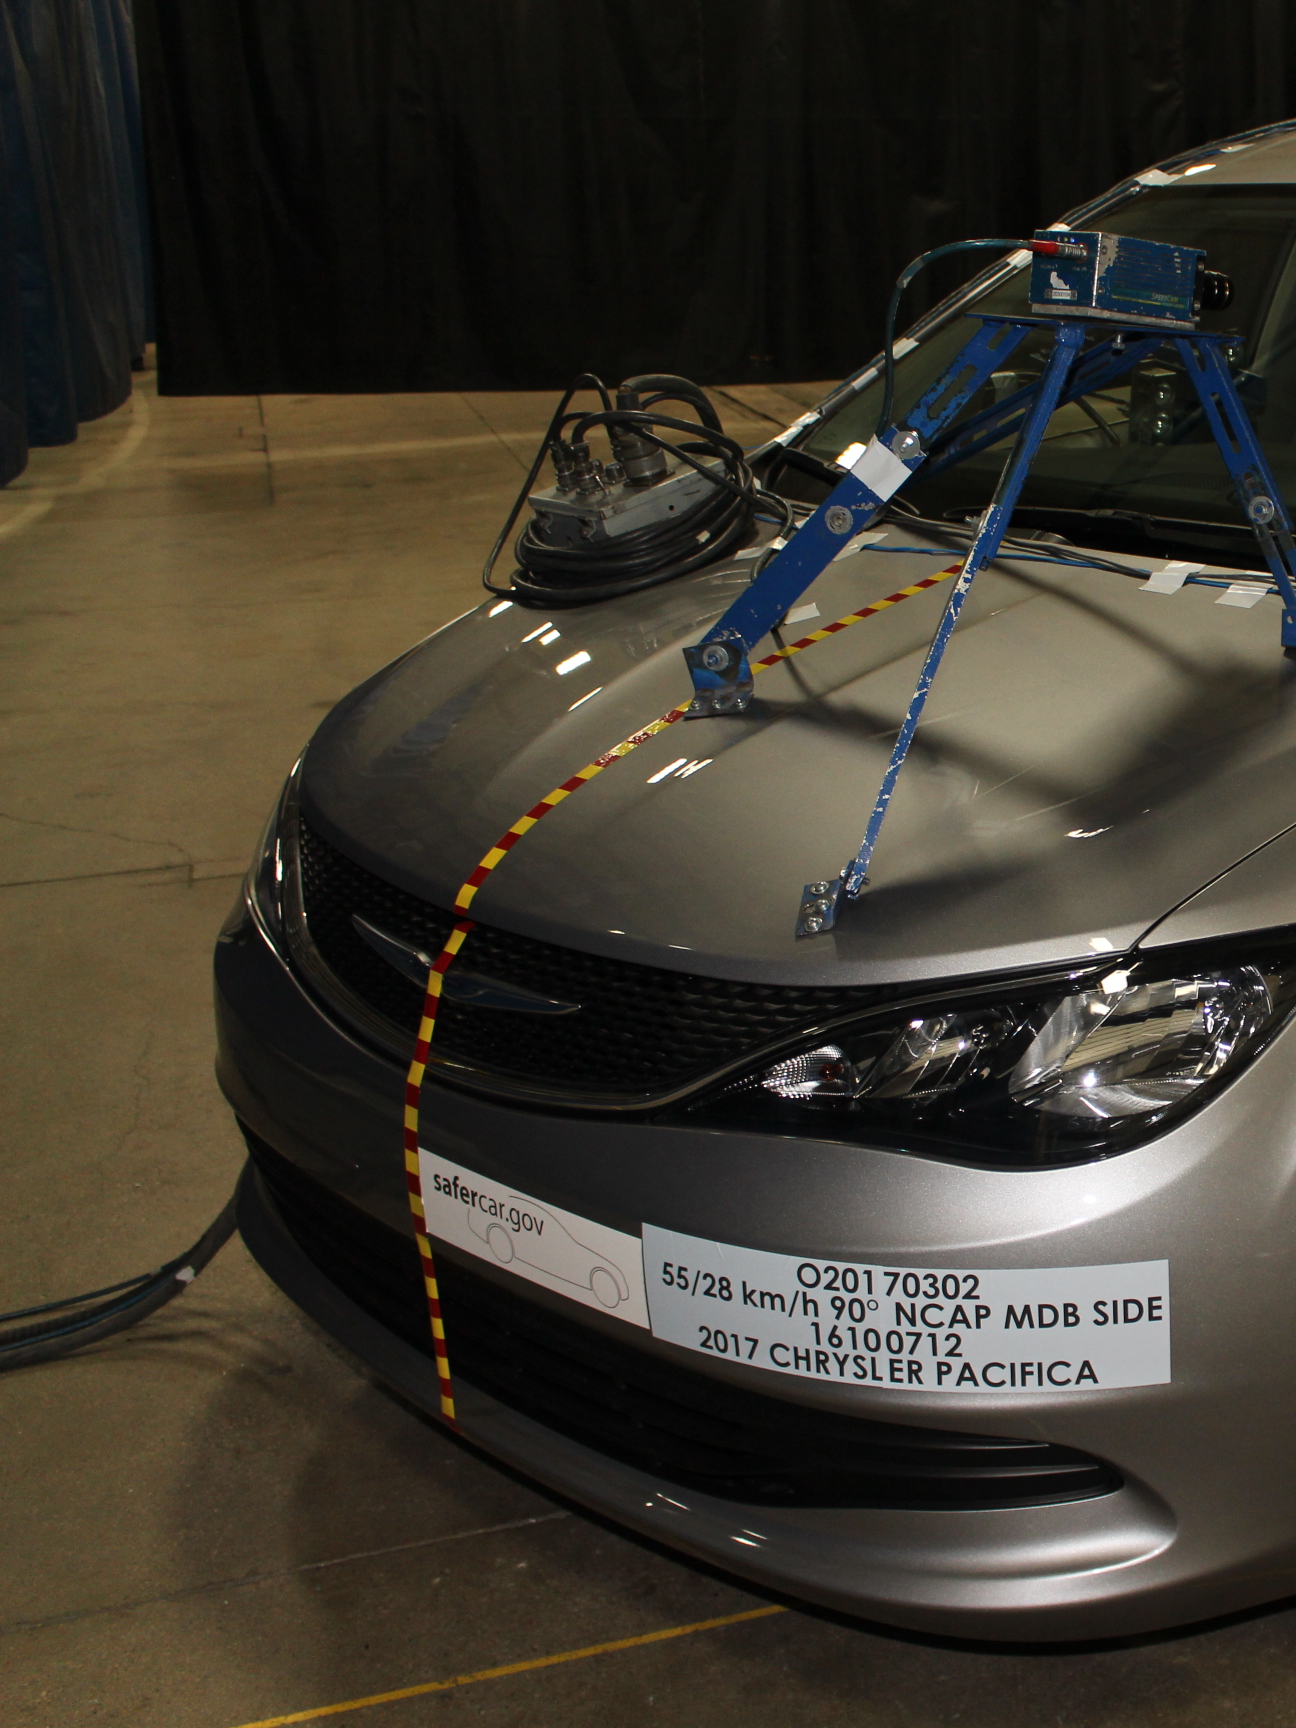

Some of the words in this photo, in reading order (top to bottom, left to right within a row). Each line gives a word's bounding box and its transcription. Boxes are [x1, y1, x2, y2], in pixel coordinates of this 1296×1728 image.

[433, 1172, 544, 1236] safercar.gov
[661, 1261, 733, 1301] 55/28
[742, 1281, 820, 1318] km/h
[895, 1301, 991, 1329] NCAP
[1004, 1303, 1081, 1330] MDB
[1092, 1296, 1163, 1326] SIDE
[698, 1325, 759, 1361] 2017
[769, 1342, 924, 1385] CHRYSLER
[936, 1360, 1100, 1387] PACIFICA
[810, 1321, 963, 1358] 16100712
